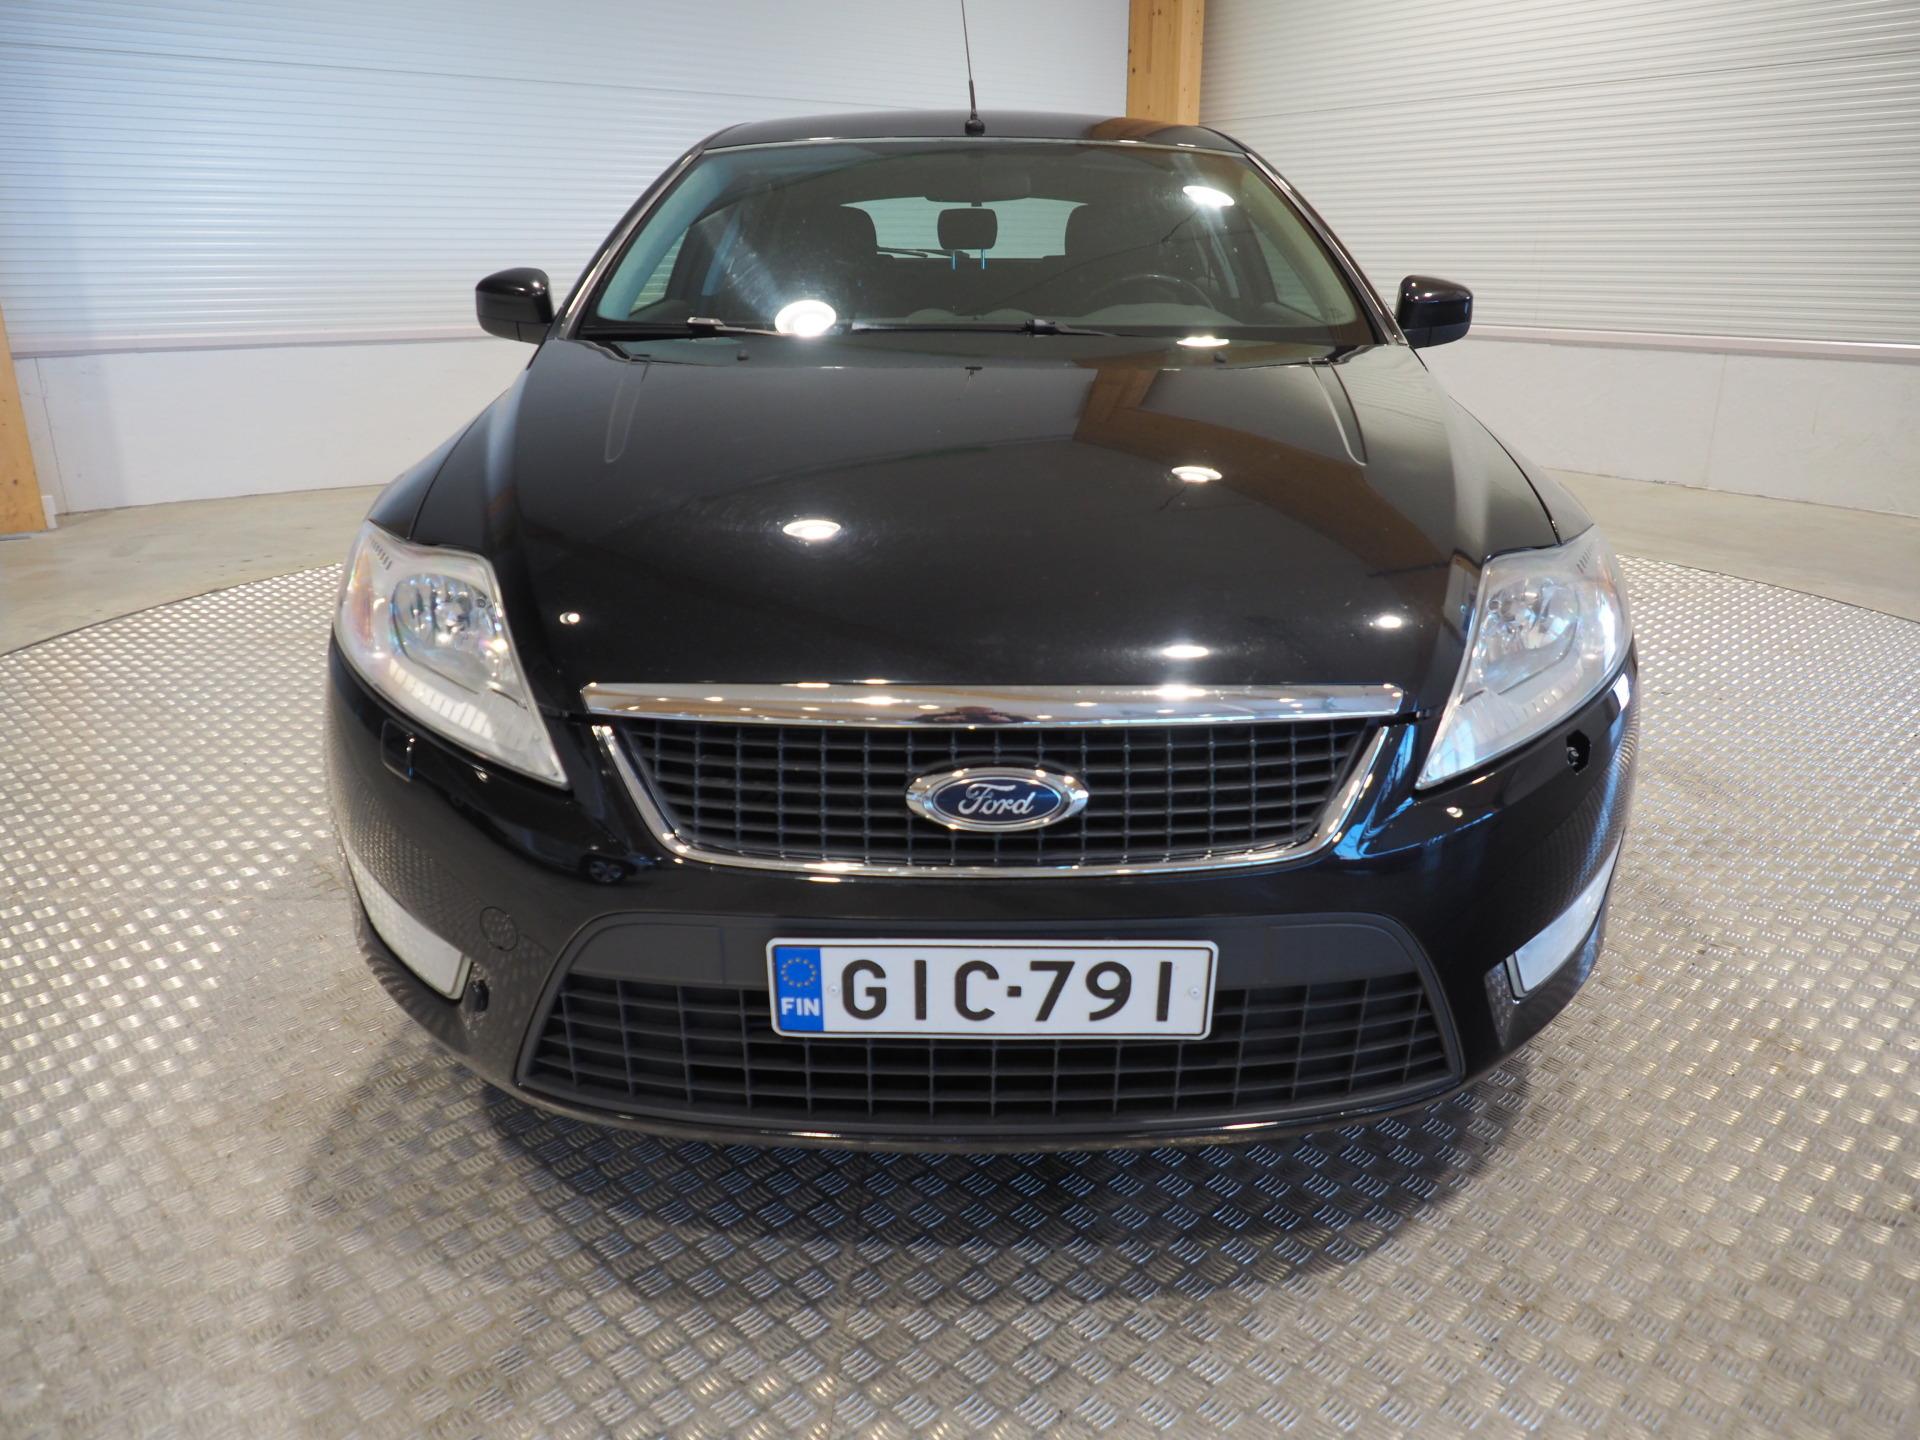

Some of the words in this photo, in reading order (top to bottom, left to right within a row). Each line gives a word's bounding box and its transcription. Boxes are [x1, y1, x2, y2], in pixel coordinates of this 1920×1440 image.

[957, 783, 1036, 815] Ford
[841, 959, 1173, 1022] GIC-791
[780, 997, 820, 1017] FIN
